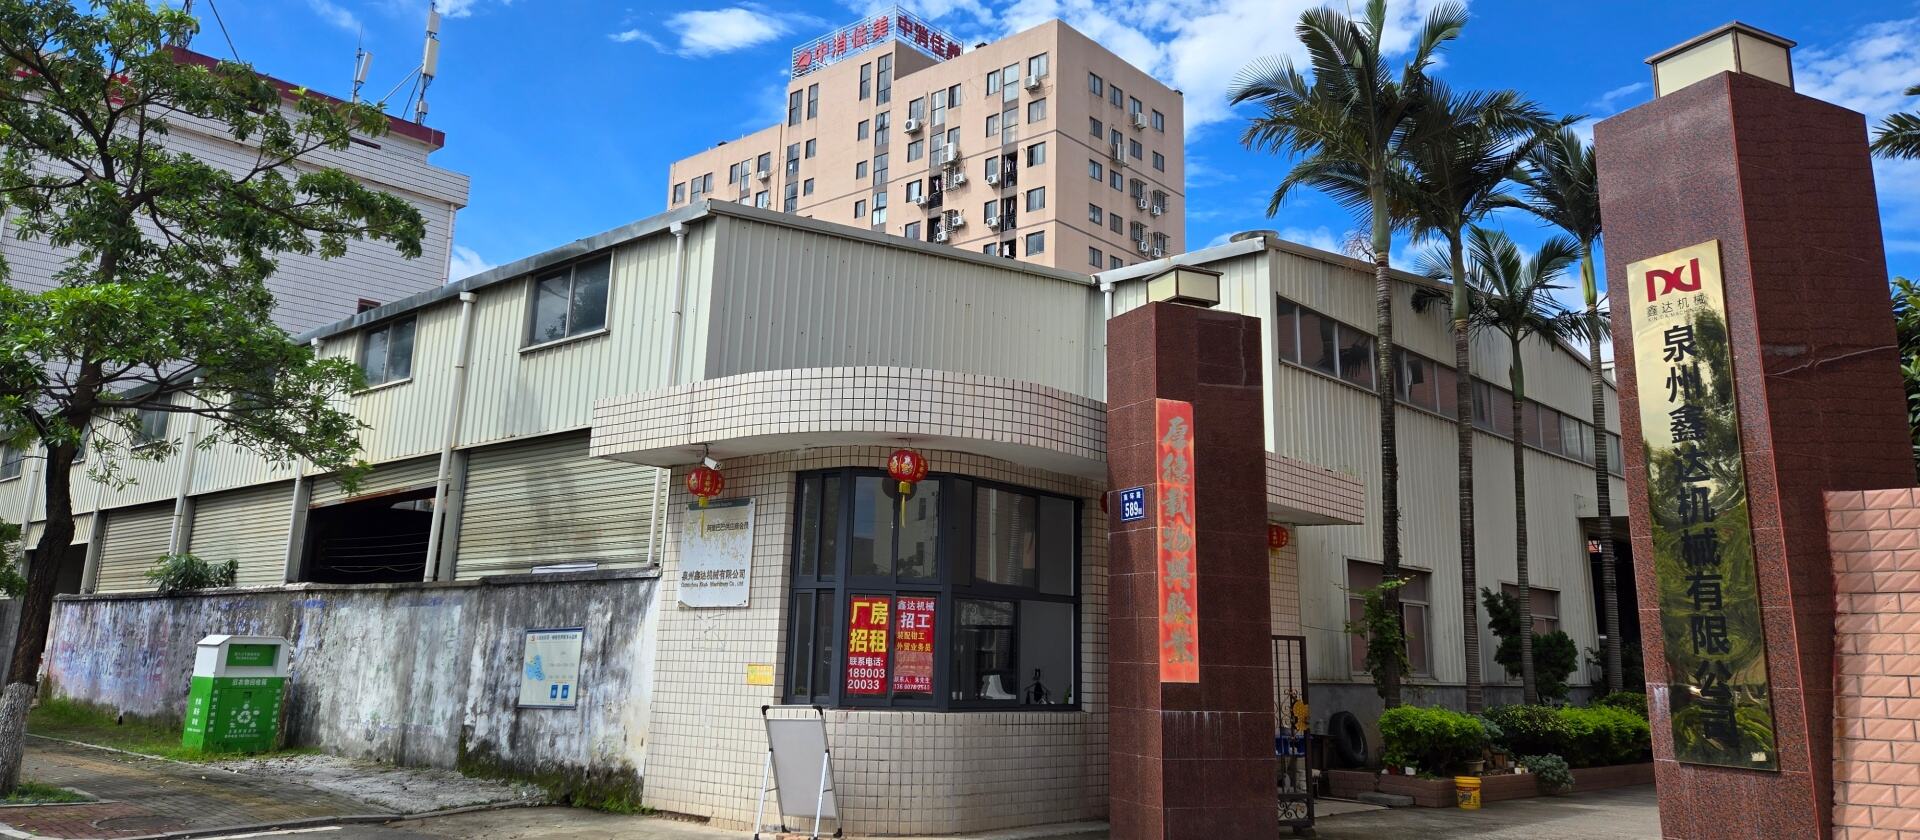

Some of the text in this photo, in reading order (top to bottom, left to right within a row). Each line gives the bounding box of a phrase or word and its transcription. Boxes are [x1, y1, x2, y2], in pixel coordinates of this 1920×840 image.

[814, 16, 889, 64] 中消佳美
[1648, 293, 1708, 317] 鑫达机械
[1662, 325, 1738, 748] 泉州鑫达机械有限公司
[682, 569, 746, 581] 泉州鑫达机械有限公司
[852, 602, 888, 624] 厂房
[898, 600, 934, 611] 鑫达机械
[901, 612, 930, 628] 招工
[850, 629, 887, 653] 招租
[848, 668, 885, 678] 189003
[847, 679, 879, 690] 20033
